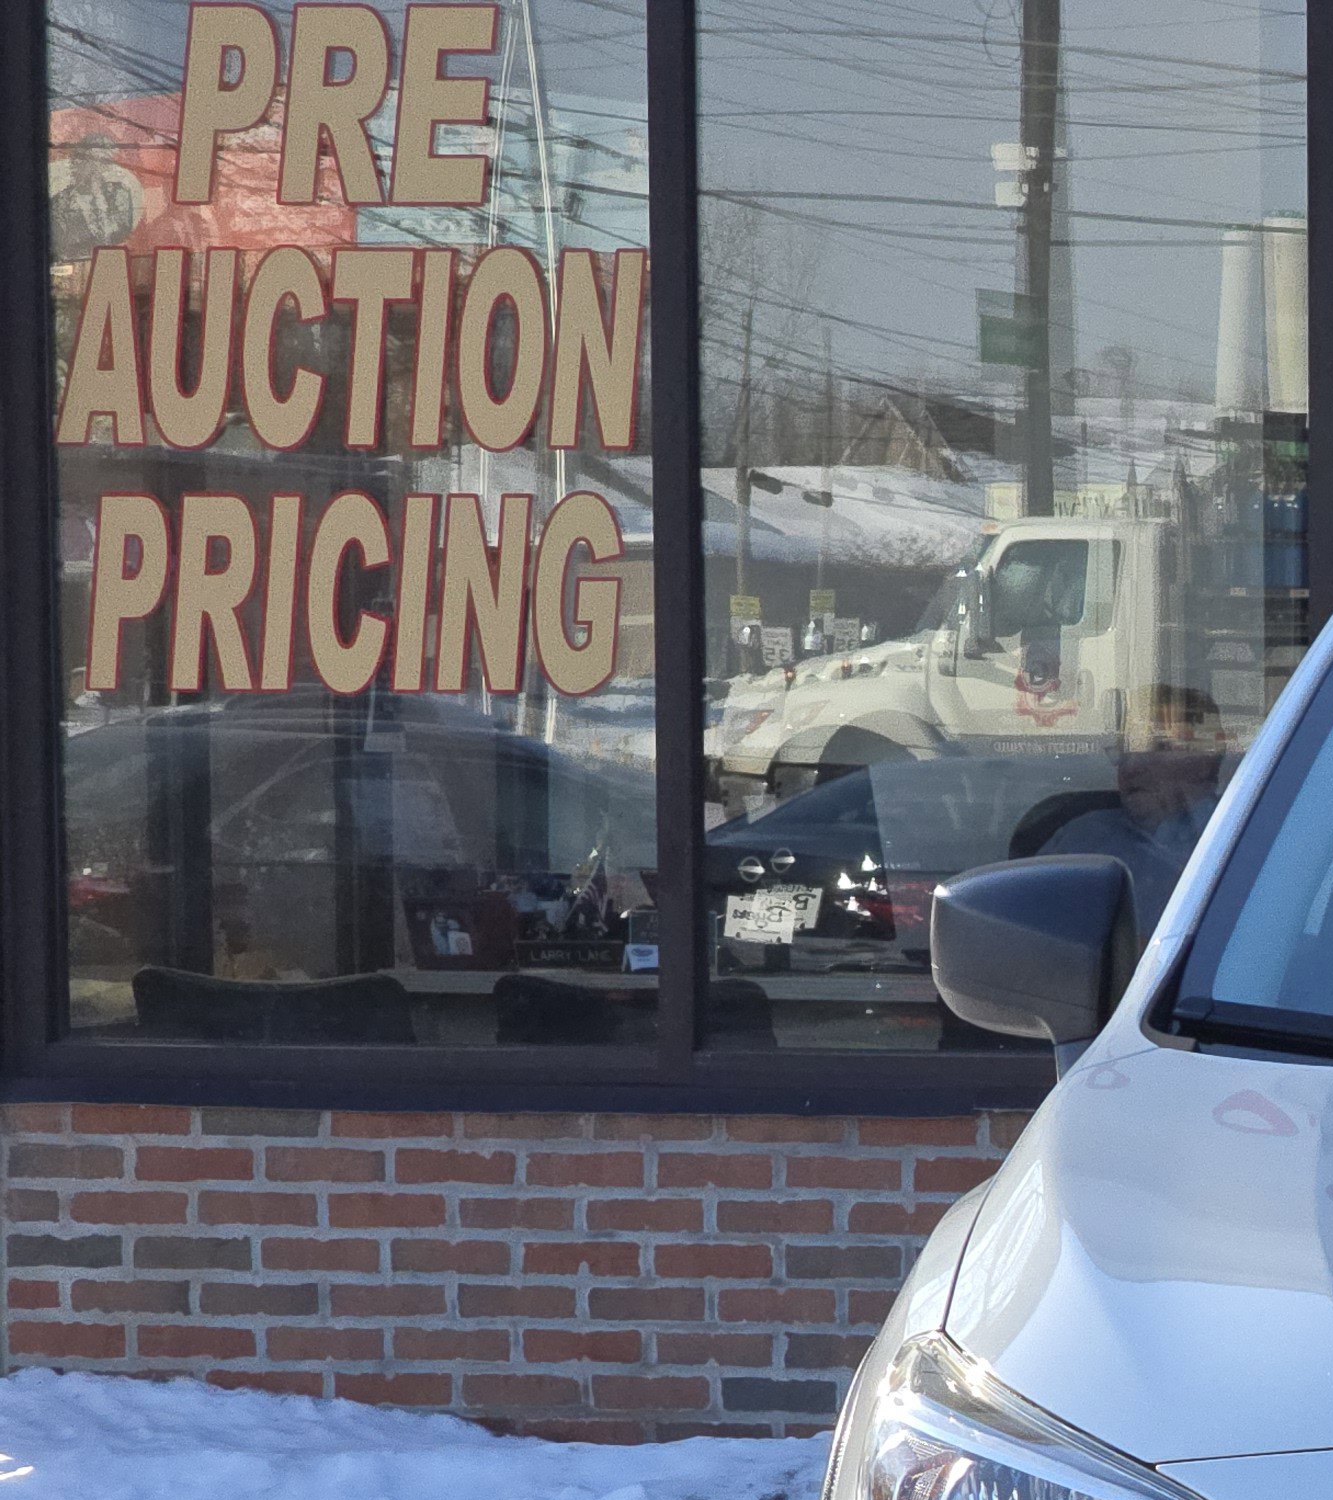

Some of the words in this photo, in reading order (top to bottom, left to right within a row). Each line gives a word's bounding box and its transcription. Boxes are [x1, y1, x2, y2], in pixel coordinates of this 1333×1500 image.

[172, 2, 500, 205] PRE
[57, 245, 647, 452] AUCTION
[85, 492, 624, 695] PRICING
